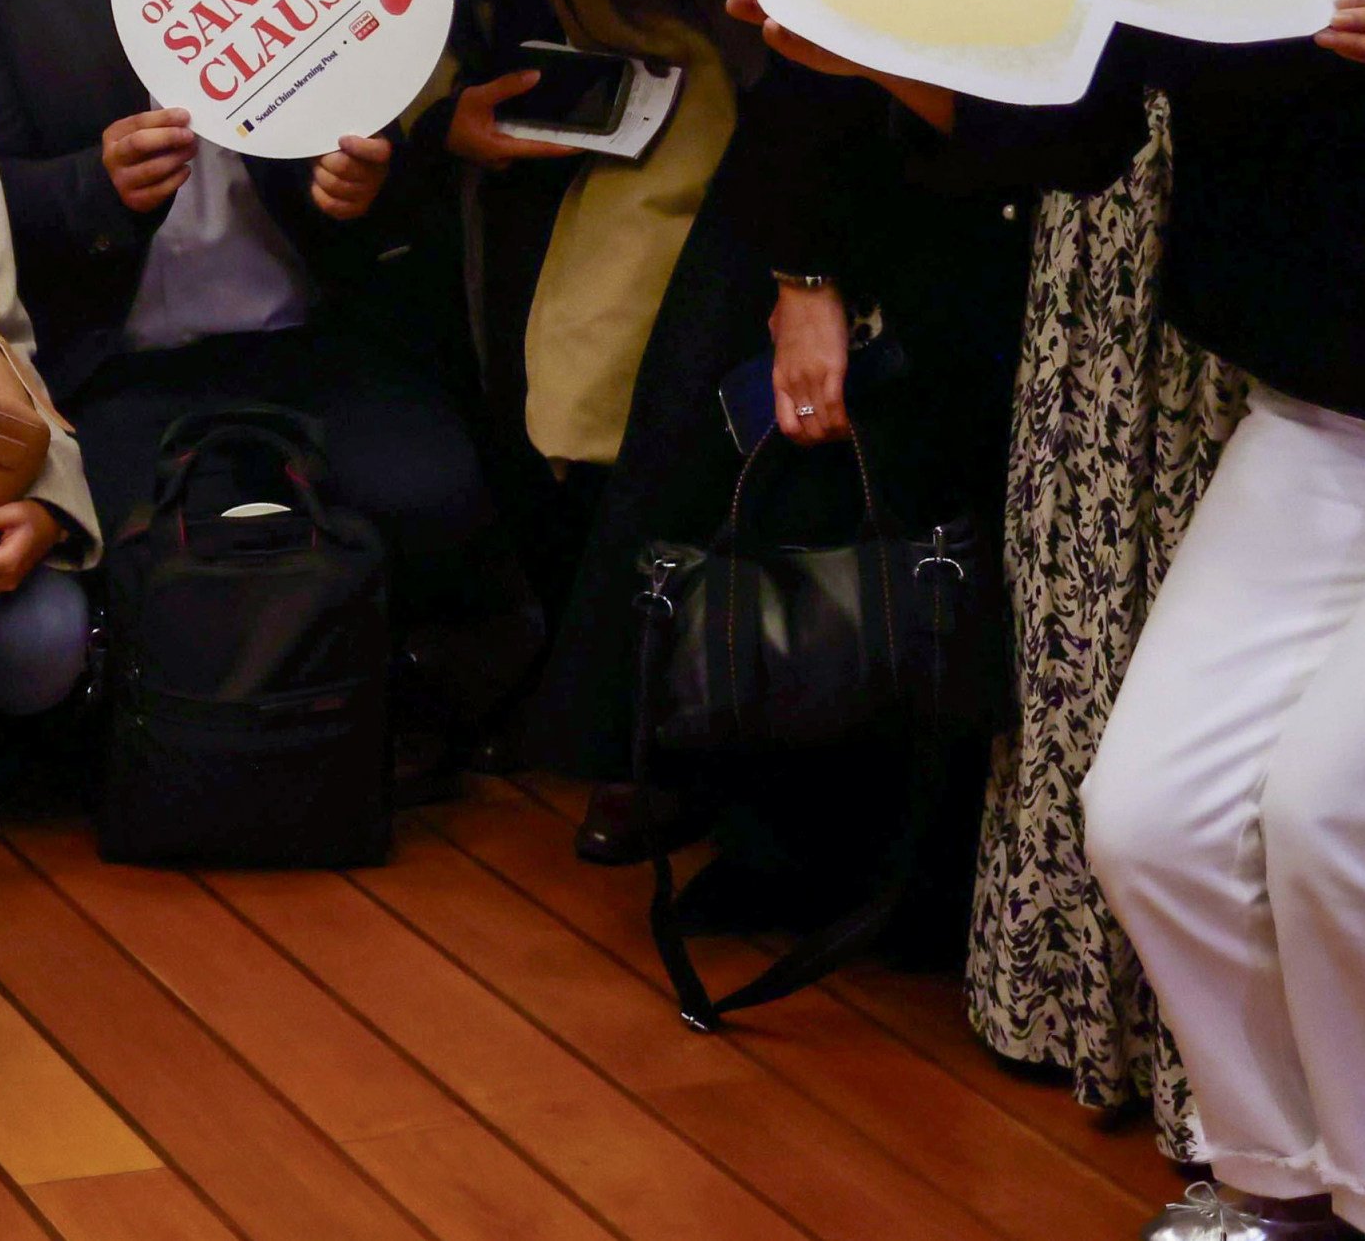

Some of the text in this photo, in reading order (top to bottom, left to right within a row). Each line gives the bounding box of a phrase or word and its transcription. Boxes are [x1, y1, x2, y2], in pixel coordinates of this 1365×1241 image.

[255, 50, 338, 123] South China Morning Post
